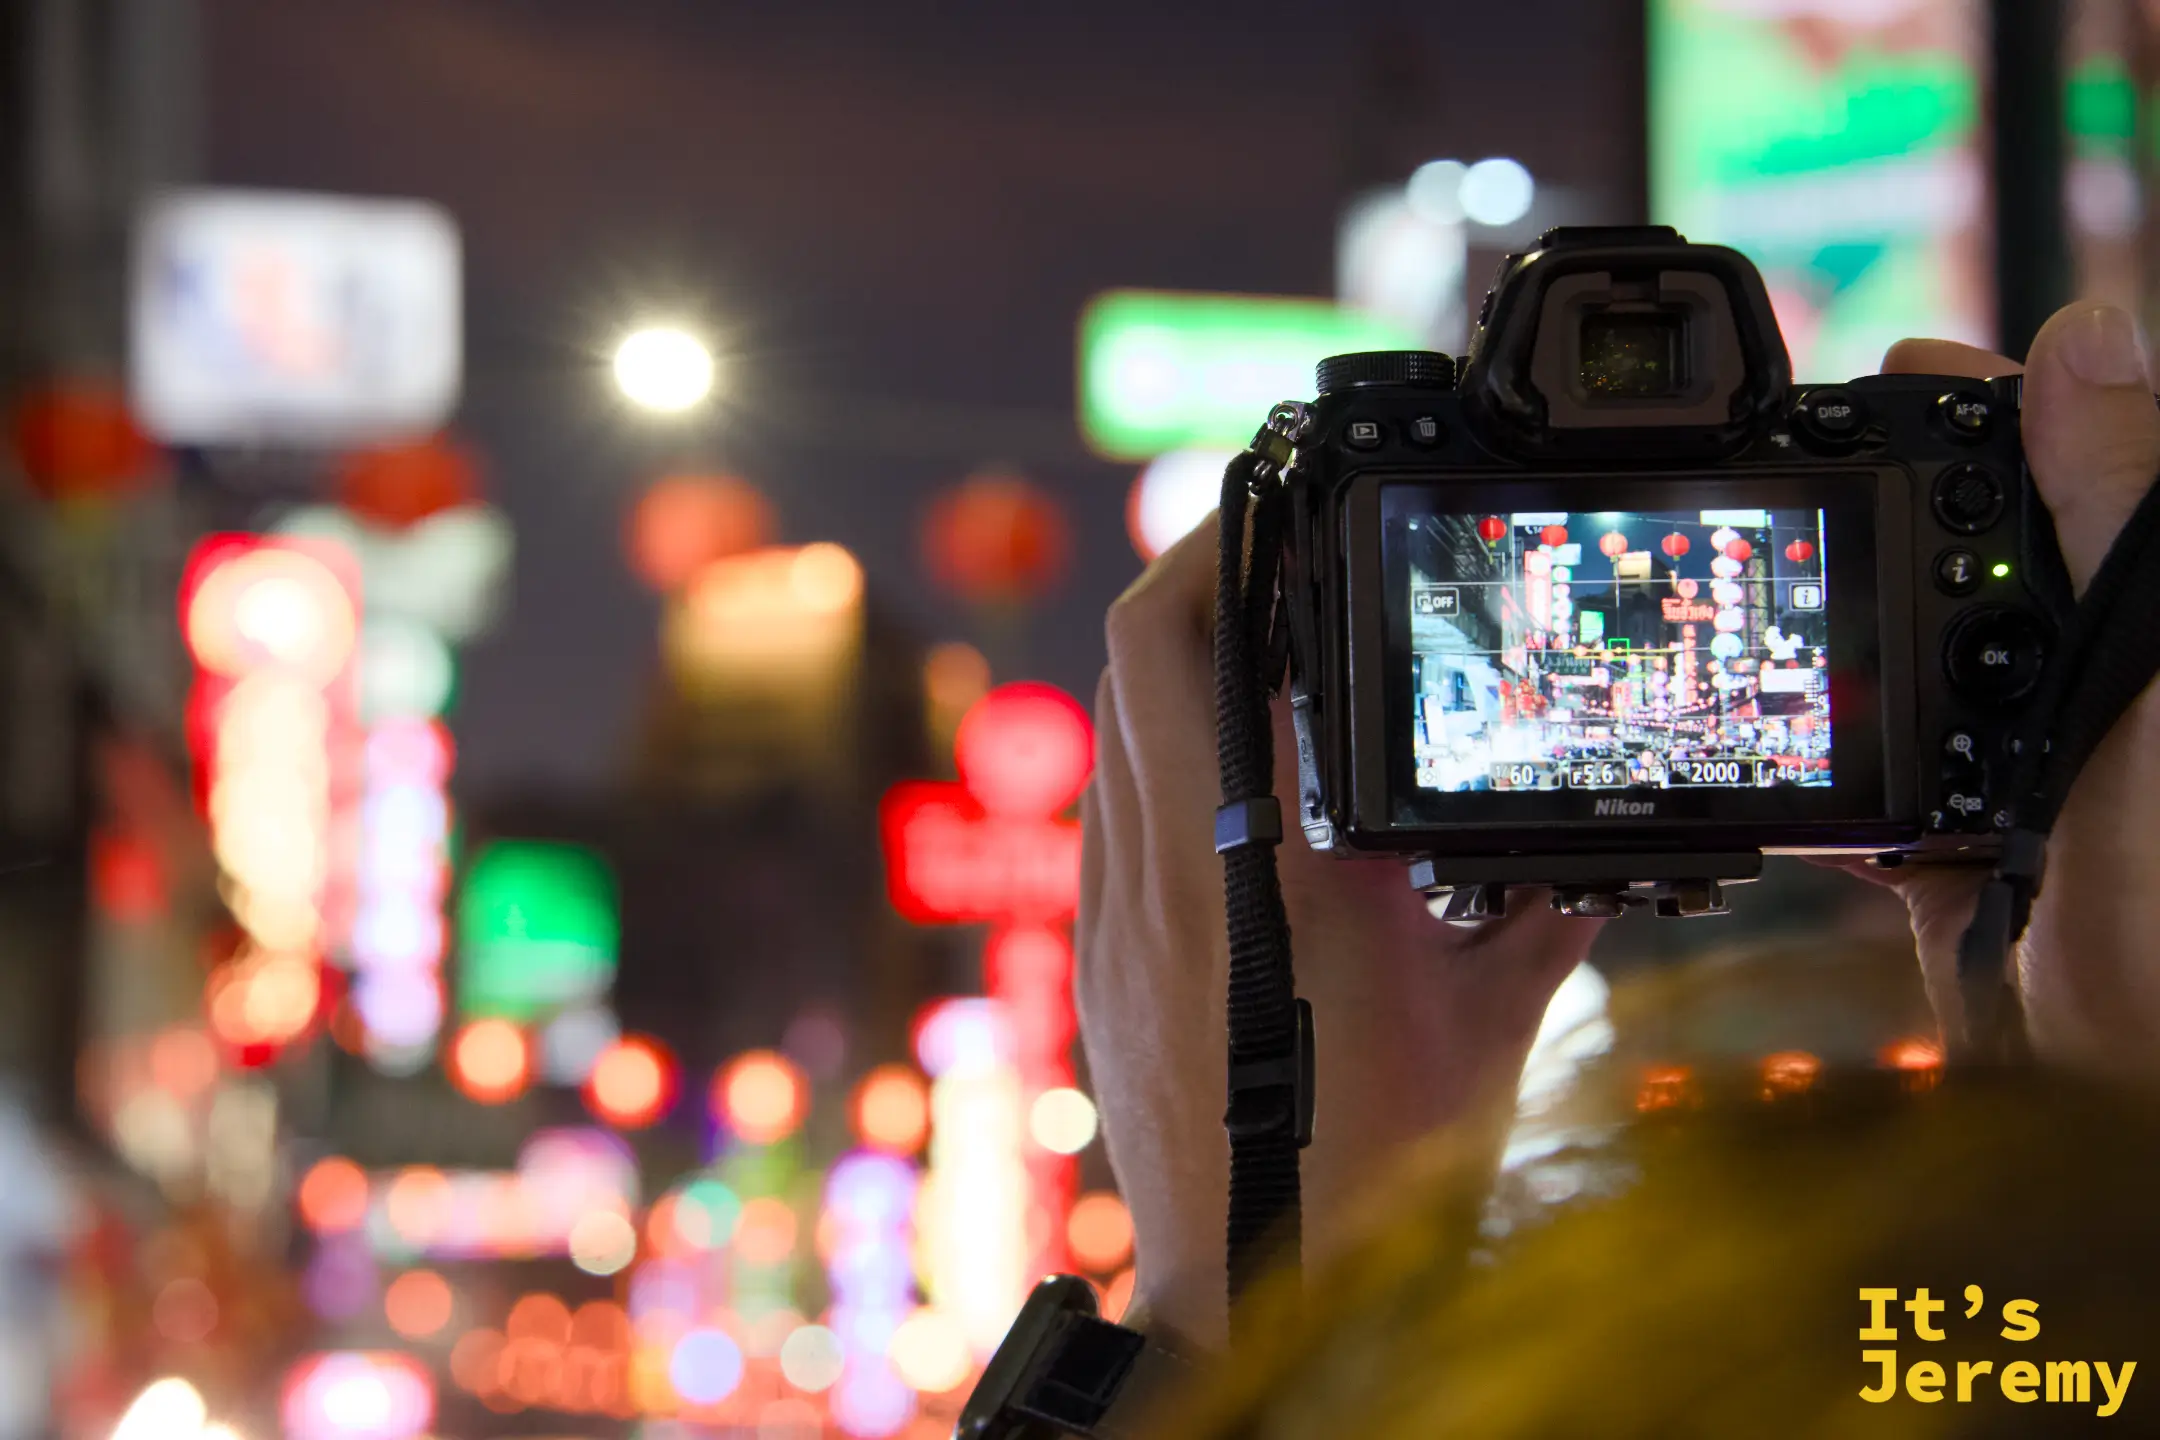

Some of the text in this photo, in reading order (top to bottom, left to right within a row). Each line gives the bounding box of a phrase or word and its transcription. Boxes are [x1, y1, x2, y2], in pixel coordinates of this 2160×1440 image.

[1818, 406, 1850, 419] DISP
[1955, 403, 1988, 416] AF-ON
[1432, 595, 1454, 609] OFF
[1984, 650, 2009, 665] OK
[1573, 763, 1614, 785] F5.6
[1671, 761, 1690, 772] ISO
[1691, 761, 1740, 783] 2000
[1594, 798, 1655, 816] Nikon
